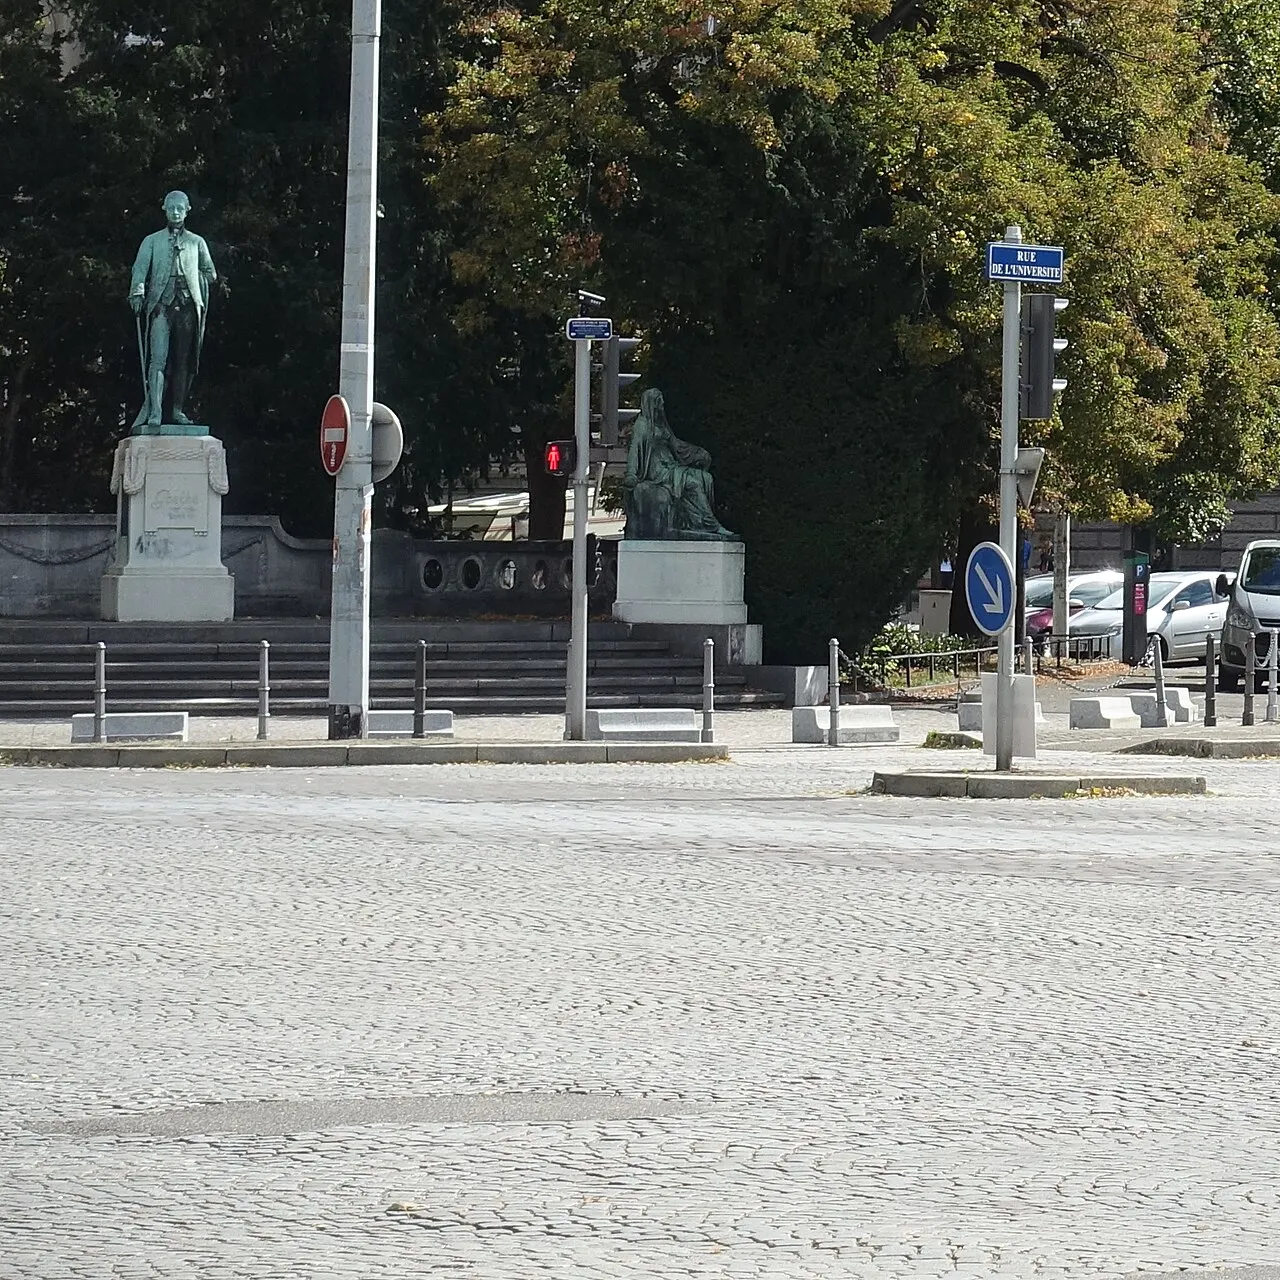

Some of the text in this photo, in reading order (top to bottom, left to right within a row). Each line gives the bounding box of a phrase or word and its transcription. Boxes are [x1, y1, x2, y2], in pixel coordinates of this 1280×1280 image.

[1017, 250, 1037, 263] RUE
[992, 263, 1004, 274] DE
[1136, 564, 1144, 577] P
